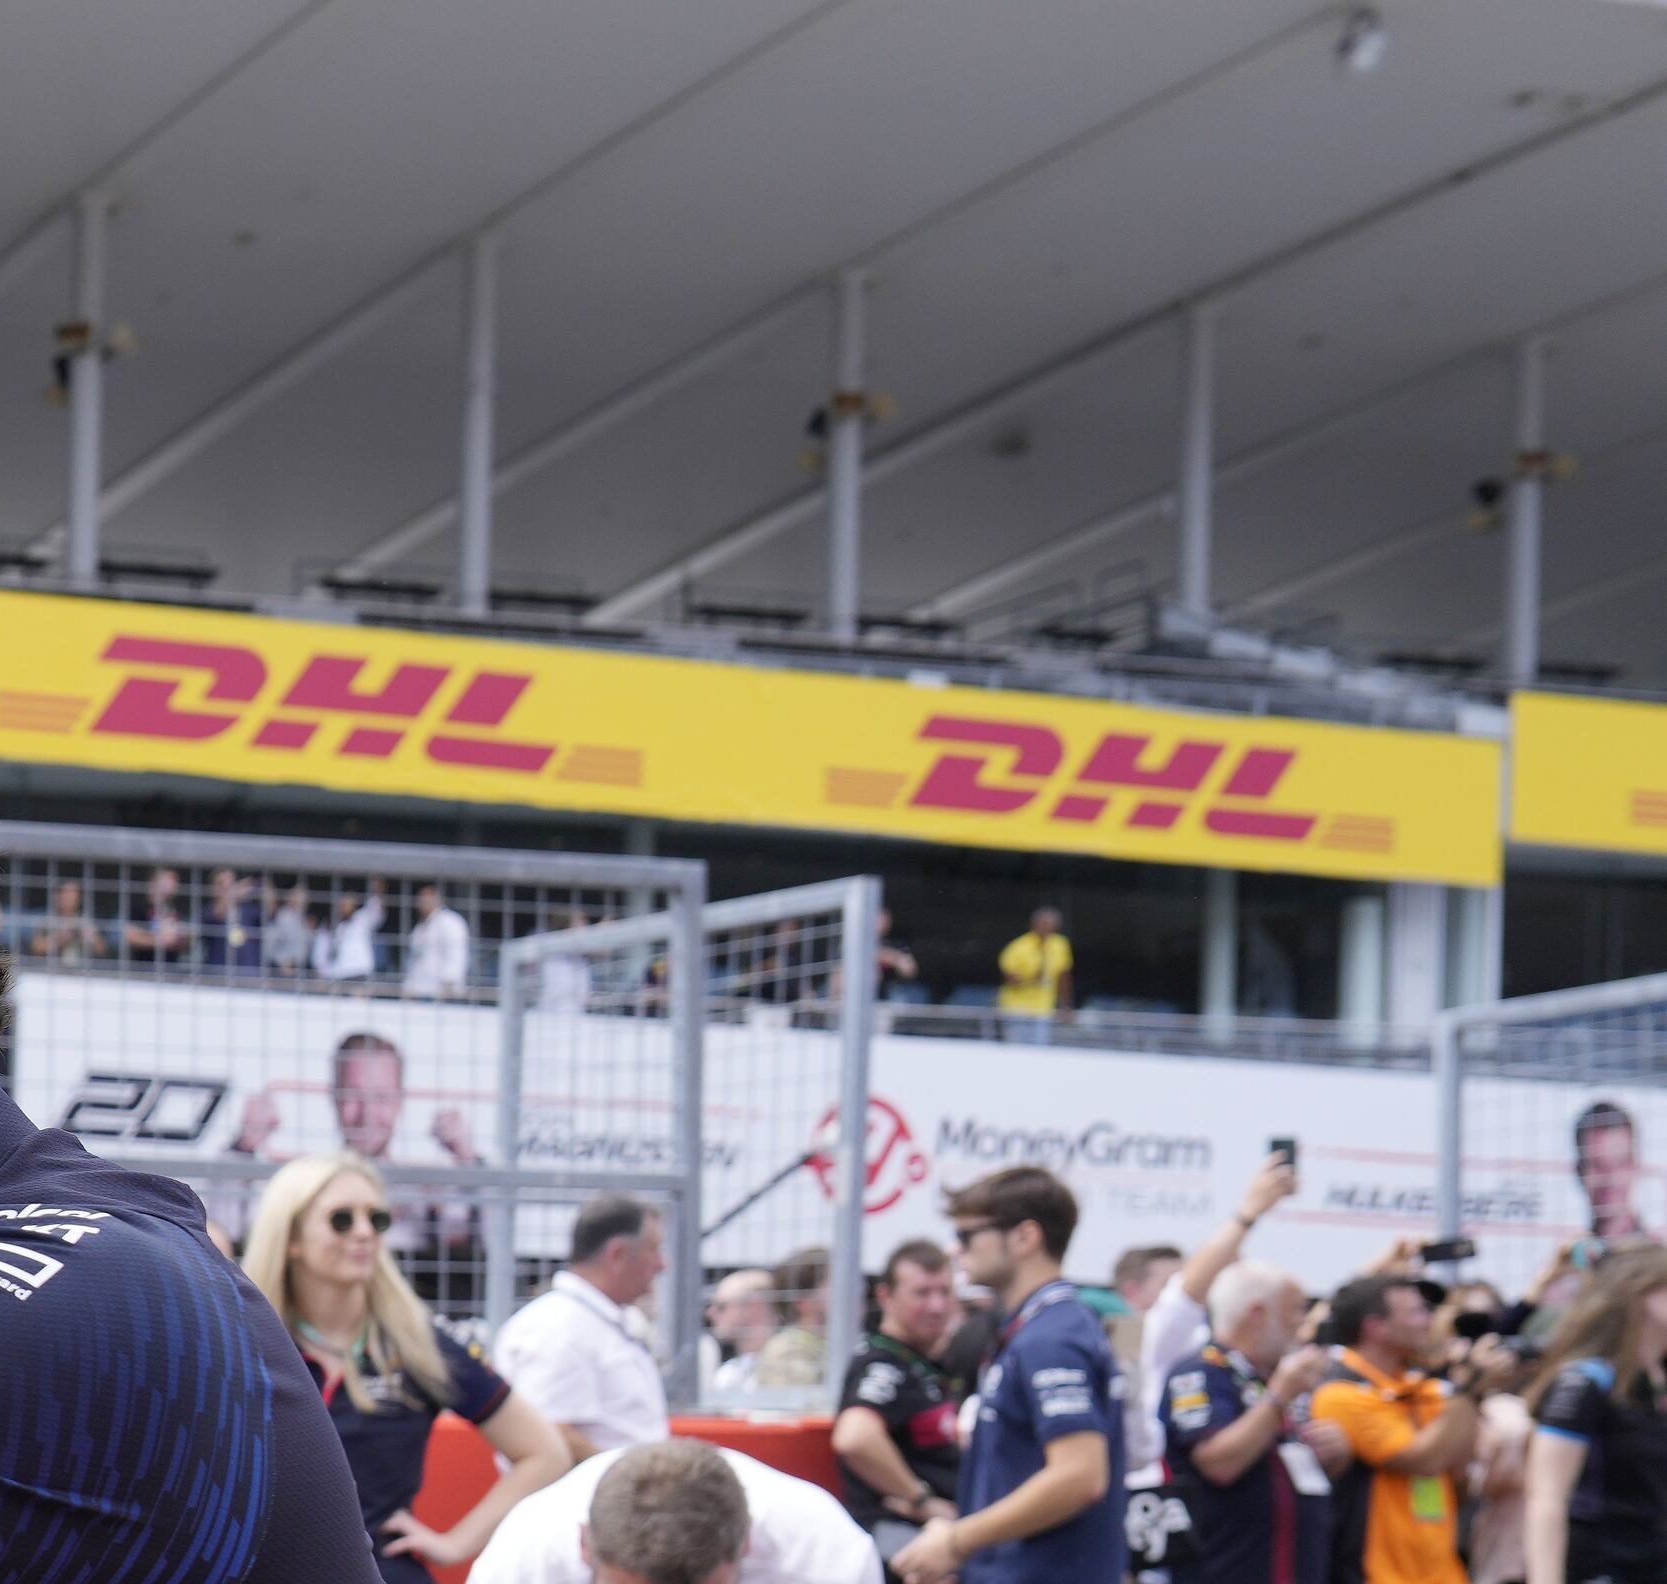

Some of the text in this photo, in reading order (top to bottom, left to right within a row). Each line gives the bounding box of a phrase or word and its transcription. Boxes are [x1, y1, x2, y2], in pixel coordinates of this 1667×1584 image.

[91, 634, 556, 774] DHL
[910, 715, 1317, 841] DHL
[61, 1075, 229, 1140] 20
[936, 1117, 1214, 1176] MoneyGram
